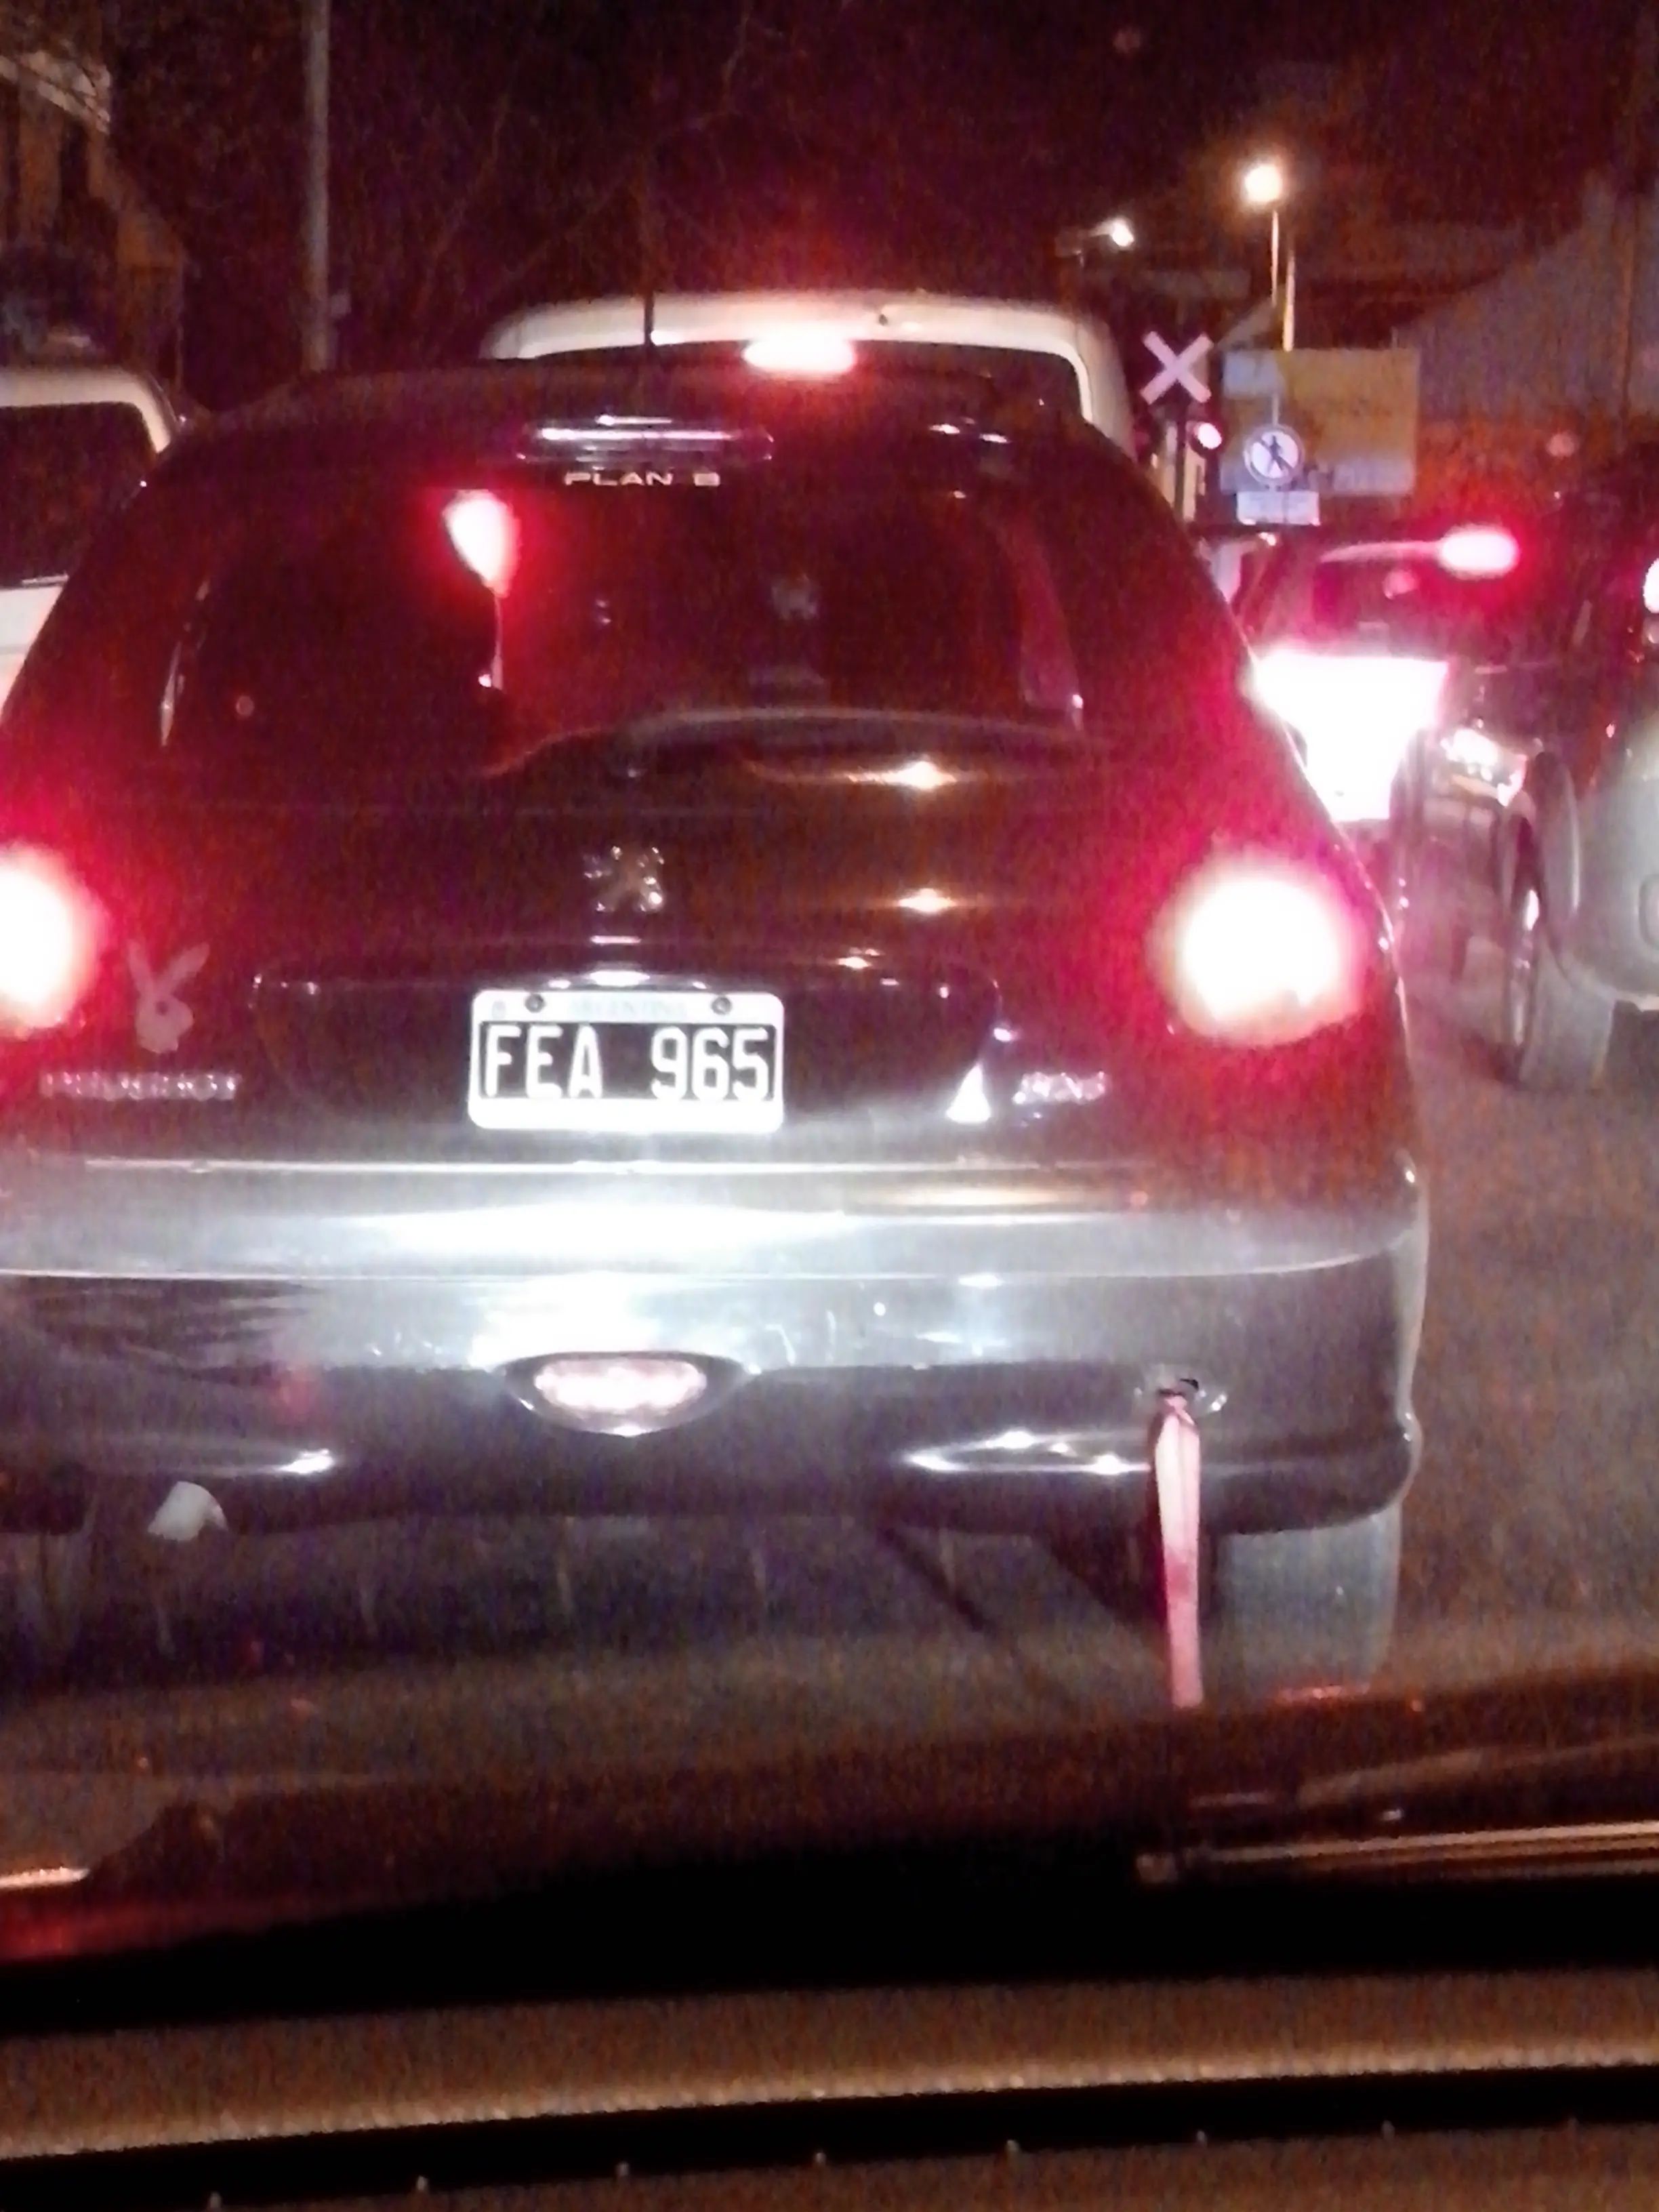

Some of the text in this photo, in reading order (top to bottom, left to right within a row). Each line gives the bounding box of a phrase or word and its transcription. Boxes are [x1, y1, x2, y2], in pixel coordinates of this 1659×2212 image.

[564, 471, 675, 486] PLAN
[485, 1025, 770, 1101] FEA 965
